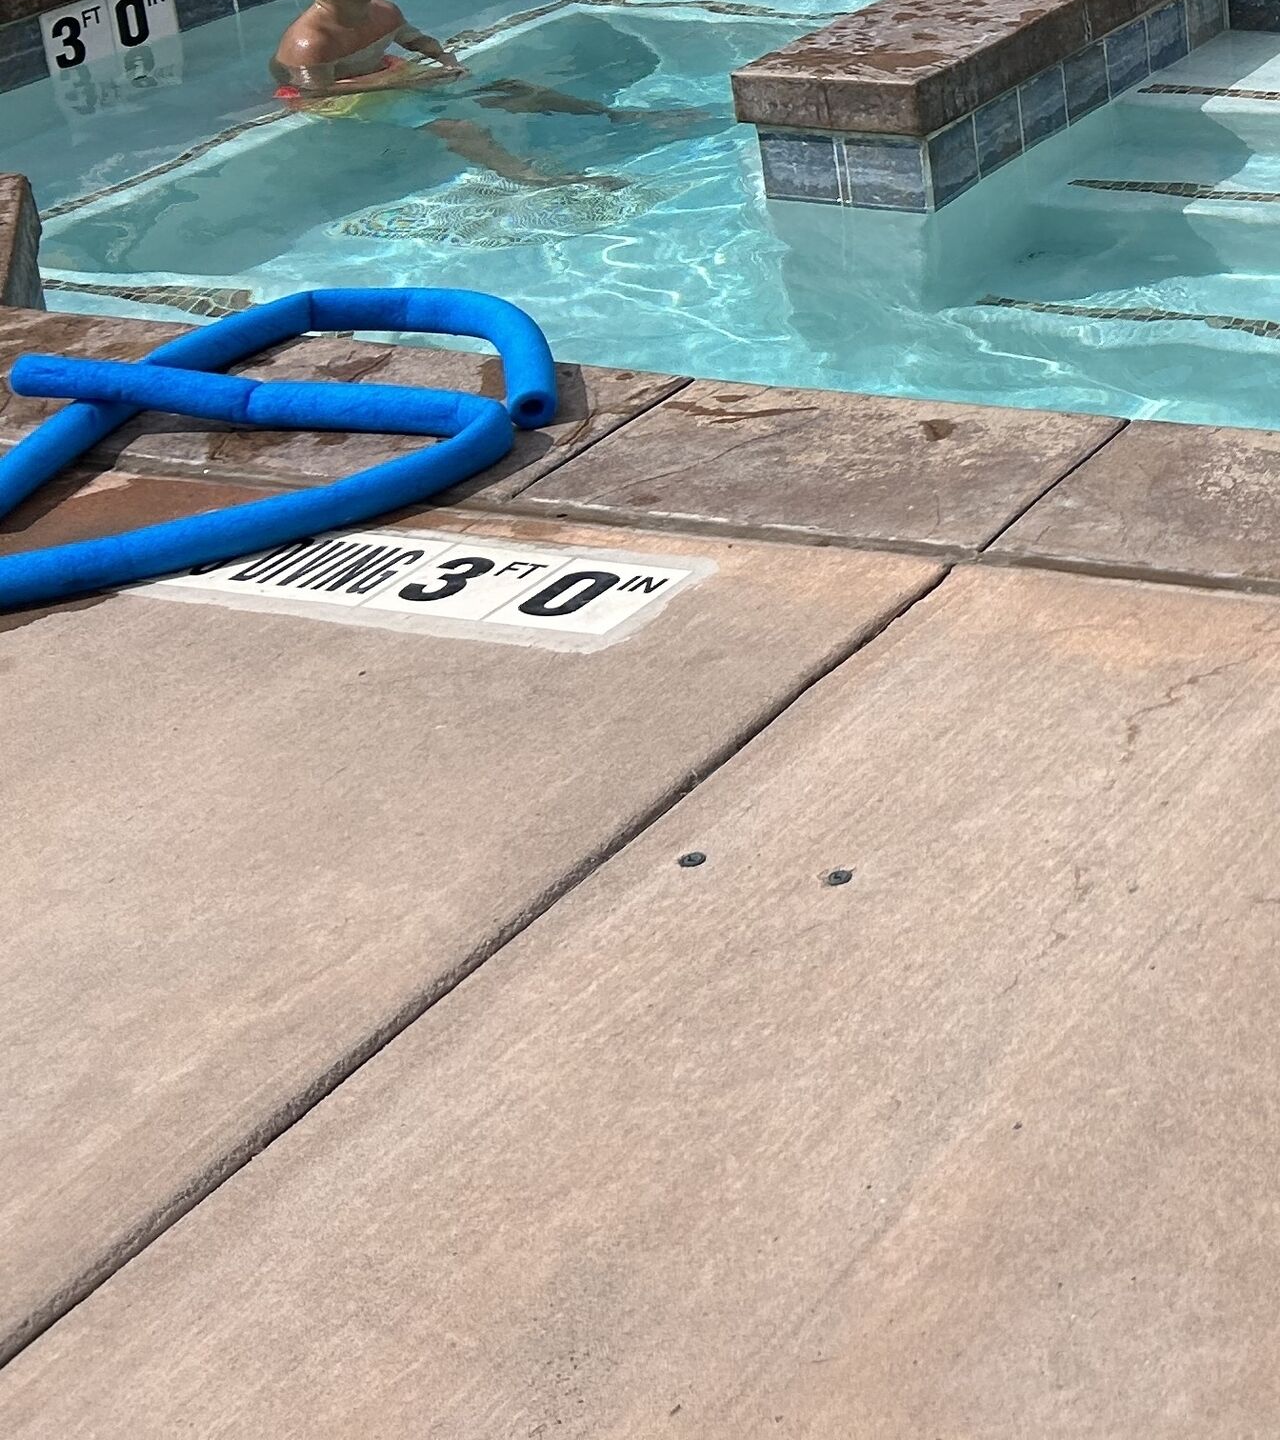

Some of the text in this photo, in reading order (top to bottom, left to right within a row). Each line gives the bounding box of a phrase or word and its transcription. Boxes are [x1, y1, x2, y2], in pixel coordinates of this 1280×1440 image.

[52, 16, 86, 69] 3
[81, 6, 101, 28] FT
[228, 537, 425, 594] DIVING
[398, 556, 496, 602] 3
[493, 561, 549, 579] FT
[616, 575, 669, 594] IN
[518, 570, 621, 617] 0
